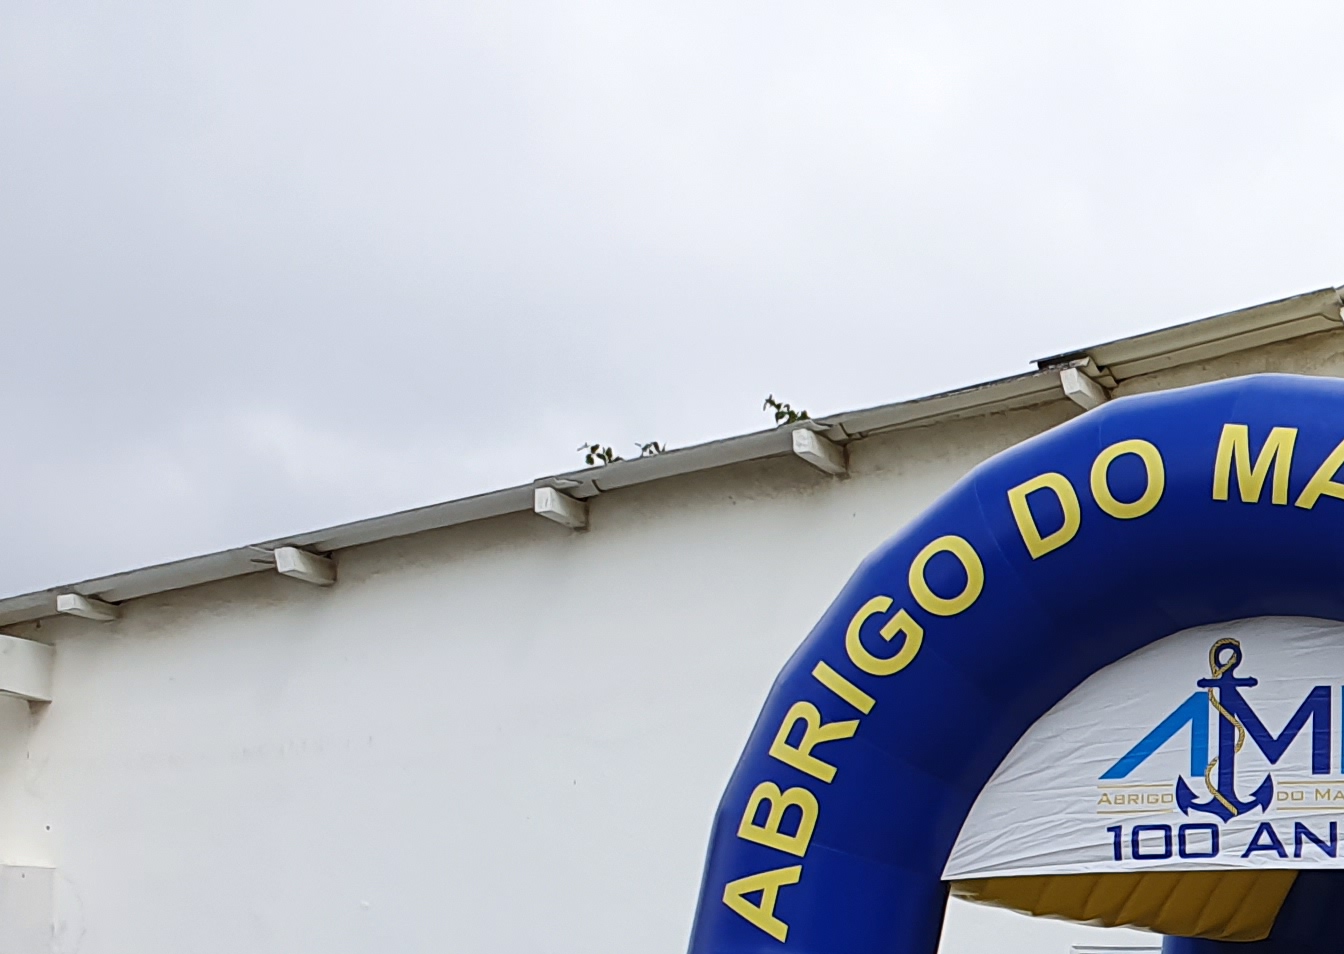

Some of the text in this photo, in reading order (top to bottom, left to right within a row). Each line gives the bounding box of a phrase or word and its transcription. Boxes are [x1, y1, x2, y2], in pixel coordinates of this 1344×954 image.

[722, 534, 985, 943] ABRIGO
[1007, 438, 1165, 560] DO
[1106, 823, 1220, 861] 100
